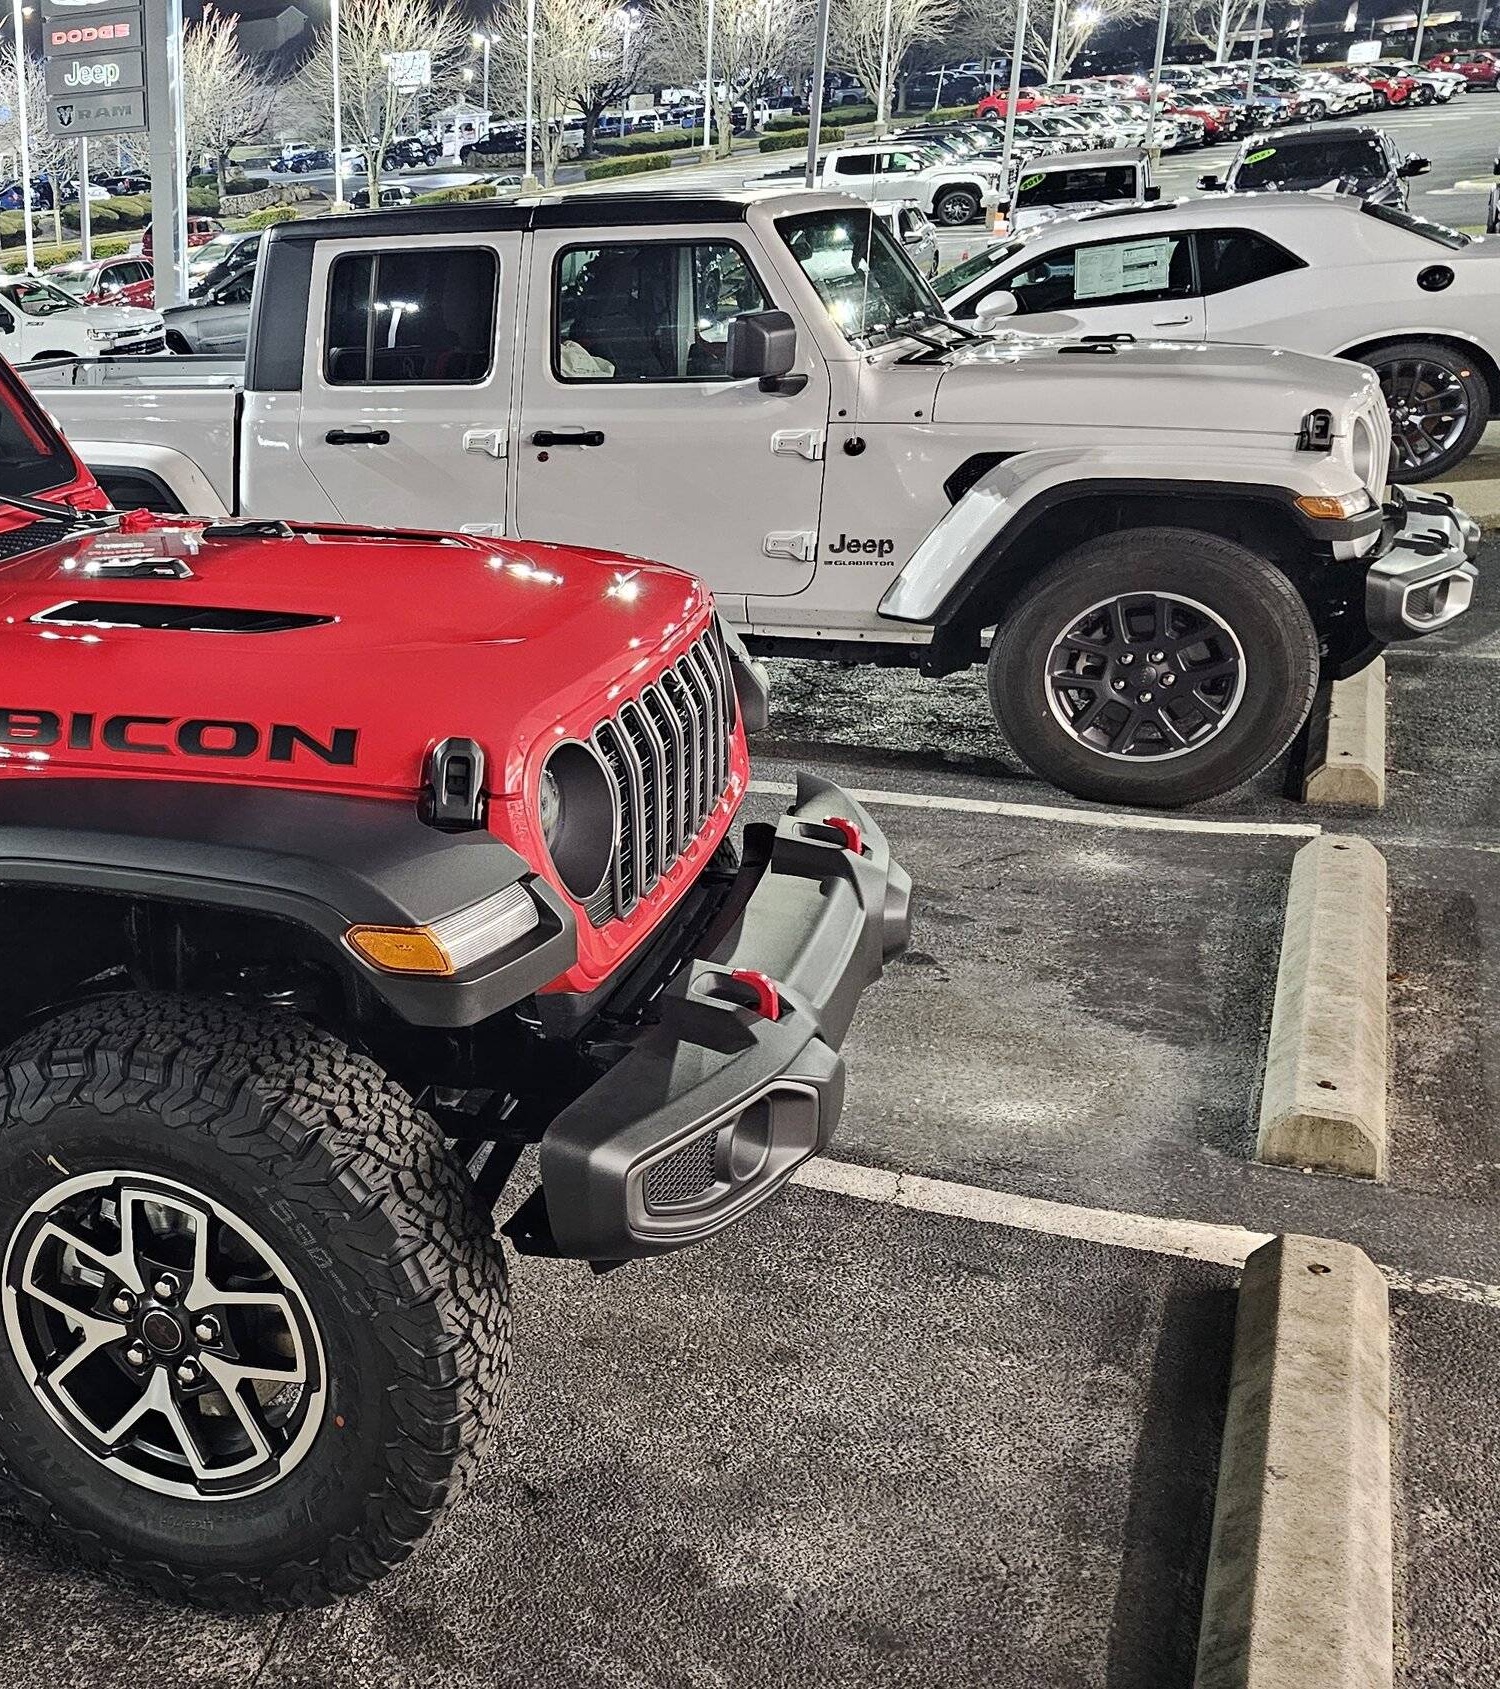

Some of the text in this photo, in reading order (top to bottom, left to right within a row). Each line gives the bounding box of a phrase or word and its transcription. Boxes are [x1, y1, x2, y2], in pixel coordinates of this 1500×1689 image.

[51, 23, 130, 45] DODGE
[64, 61, 120, 87] Jeep
[76, 105, 132, 120] RAM
[828, 533, 894, 558] Jeep
